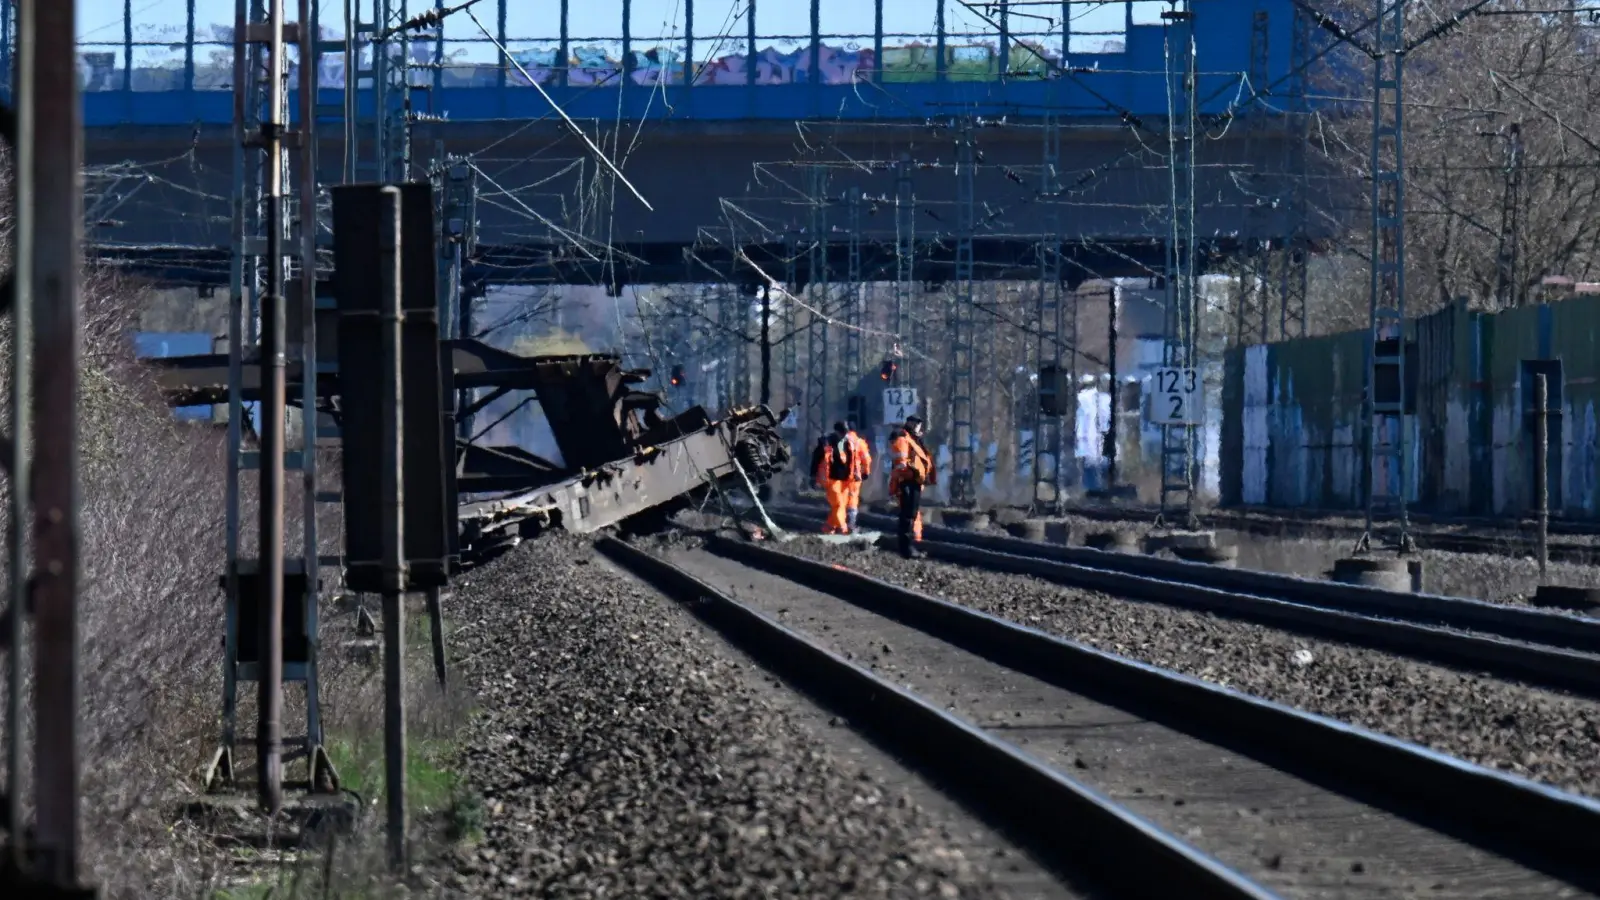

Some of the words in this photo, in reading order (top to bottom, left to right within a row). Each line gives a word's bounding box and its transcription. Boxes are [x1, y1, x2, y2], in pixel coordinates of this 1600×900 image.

[1157, 369, 1197, 393] 123
[887, 389, 913, 405] 123
[1168, 395, 1183, 419] 2
[896, 405, 905, 420] 4
